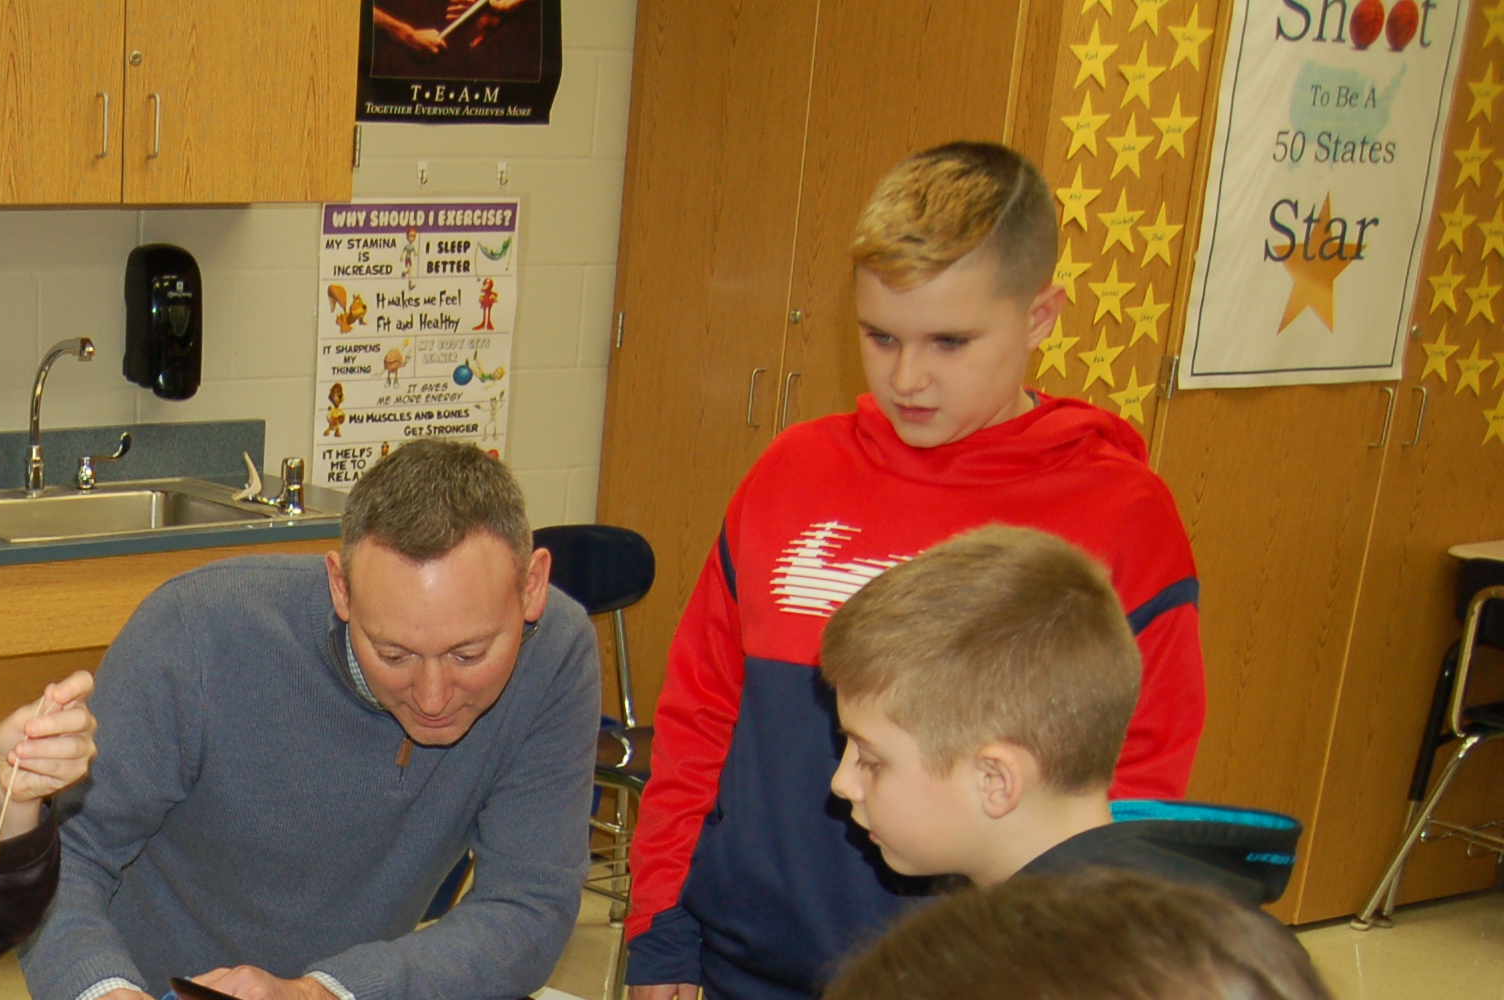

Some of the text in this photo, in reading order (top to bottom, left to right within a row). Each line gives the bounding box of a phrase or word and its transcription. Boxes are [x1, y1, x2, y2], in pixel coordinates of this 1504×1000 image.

[1310, 84, 1377, 109] To Be A
[1273, 130, 1396, 165] 50 States
[332, 209, 512, 228] WHY SHOULD I EXERCISE?
[1263, 198, 1380, 262] Star
[325, 239, 342, 250] MY
[425, 240, 471, 254] I SLEEP
[426, 260, 470, 274] BETTER
[322, 344, 381, 355] IT SHARPENS
[343, 355, 357, 364] MY
[331, 366, 372, 375] THINKING
[376, 392, 464, 406] ME MORE ENERGY
[414, 410, 434, 421] AND
[437, 409, 470, 420] BONES
[404, 423, 479, 437] GET STRONGER
[322, 447, 373, 461] IT HELPS
[330, 459, 366, 471] ME TO
[328, 470, 365, 483] RELA
